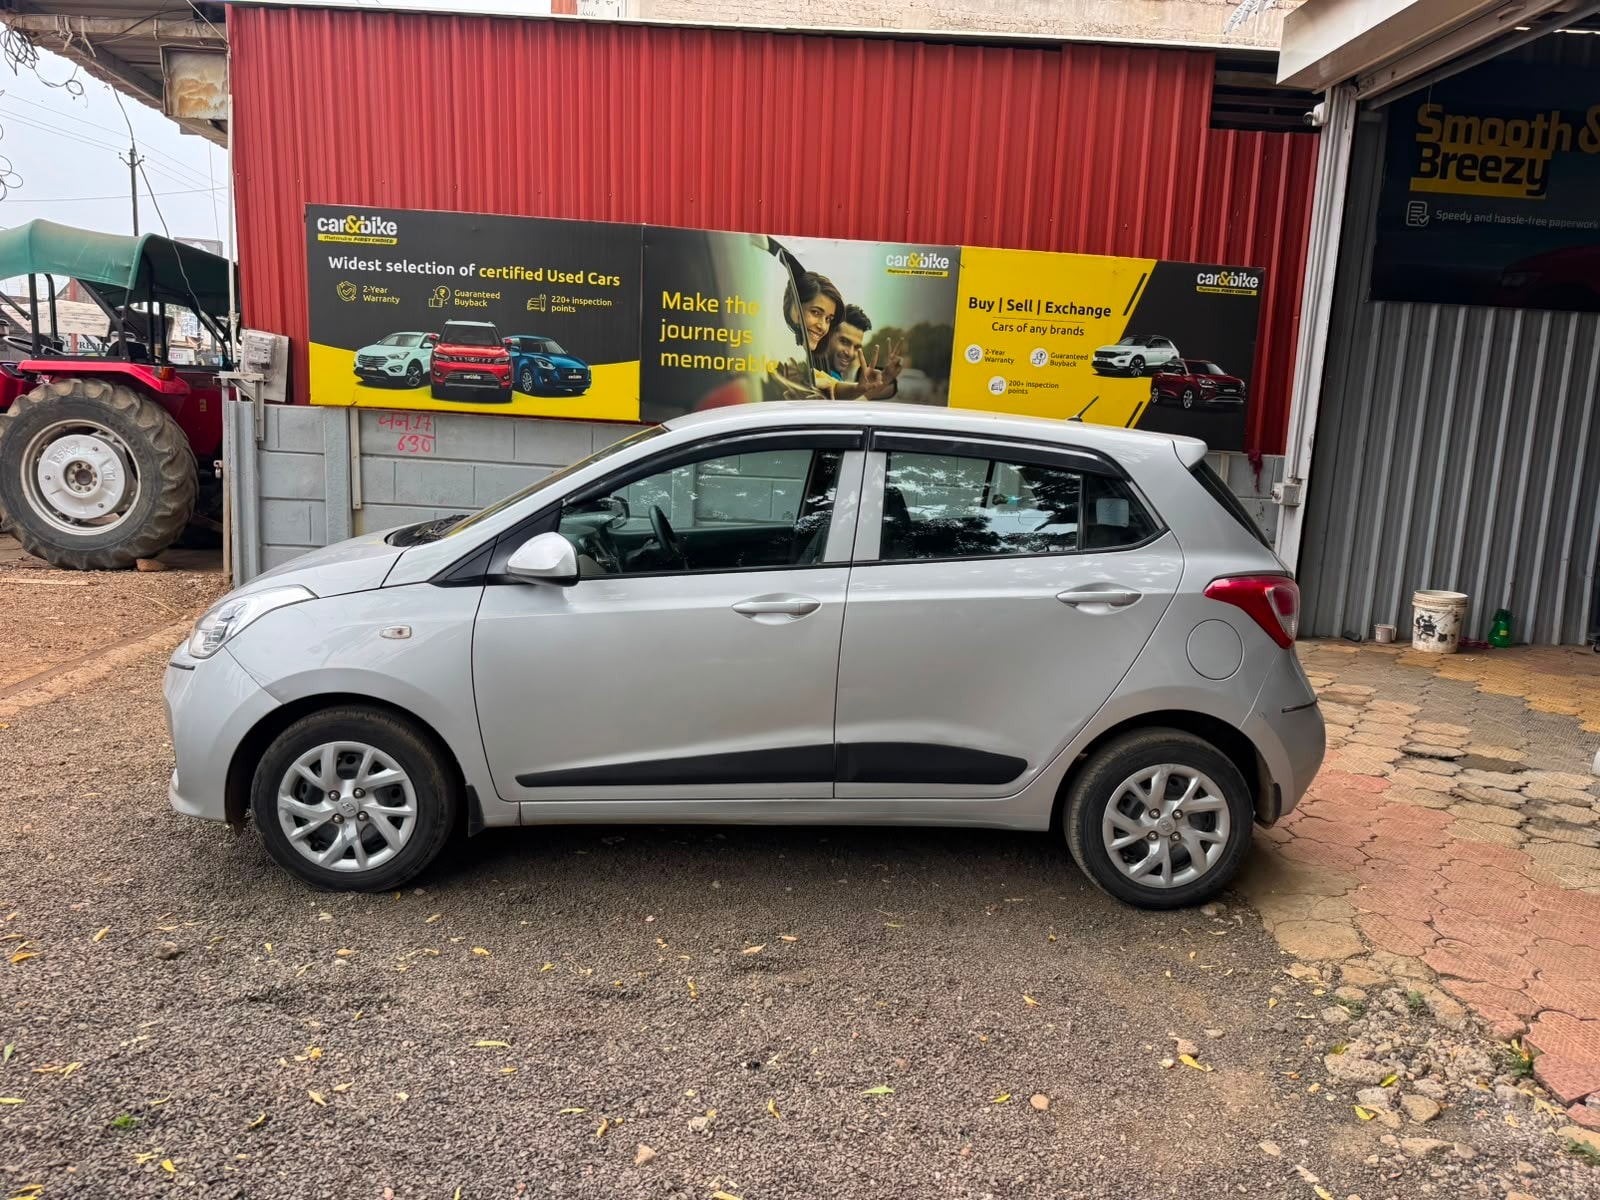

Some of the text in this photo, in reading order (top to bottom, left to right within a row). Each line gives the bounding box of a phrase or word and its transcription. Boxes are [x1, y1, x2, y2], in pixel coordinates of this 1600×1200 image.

[1416, 103, 1572, 151] Smooth
[1417, 142, 1551, 197] Breezy
[317, 215, 398, 236] car&bike
[1436, 210, 1599, 230] Speedy and hassle-free paperwork
[328, 256, 621, 287] Widest selection of certified Used Cars
[362, 285, 388, 295] 2-Year
[454, 289, 501, 299] Guaranteed
[362, 294, 400, 305] Warranty
[454, 297, 488, 308] Buyback
[551, 295, 612, 307] 220+ inspection
[662, 291, 760, 315] Make the
[551, 303, 576, 314] points
[968, 296, 1112, 318] Buy Sell Exchange
[659, 319, 753, 347] journeys
[991, 321, 1085, 337] Cars of any brands
[984, 348, 1005, 357] 2-Year
[1050, 351, 1089, 361] Guaranteed
[660, 352, 779, 374] memorable
[984, 355, 1015, 366] Warranty
[1050, 359, 1078, 368] Buyback
[1026, 380, 1059, 390] inspection
[1007, 387, 1029, 396] points
[397, 434, 431, 454] 630
